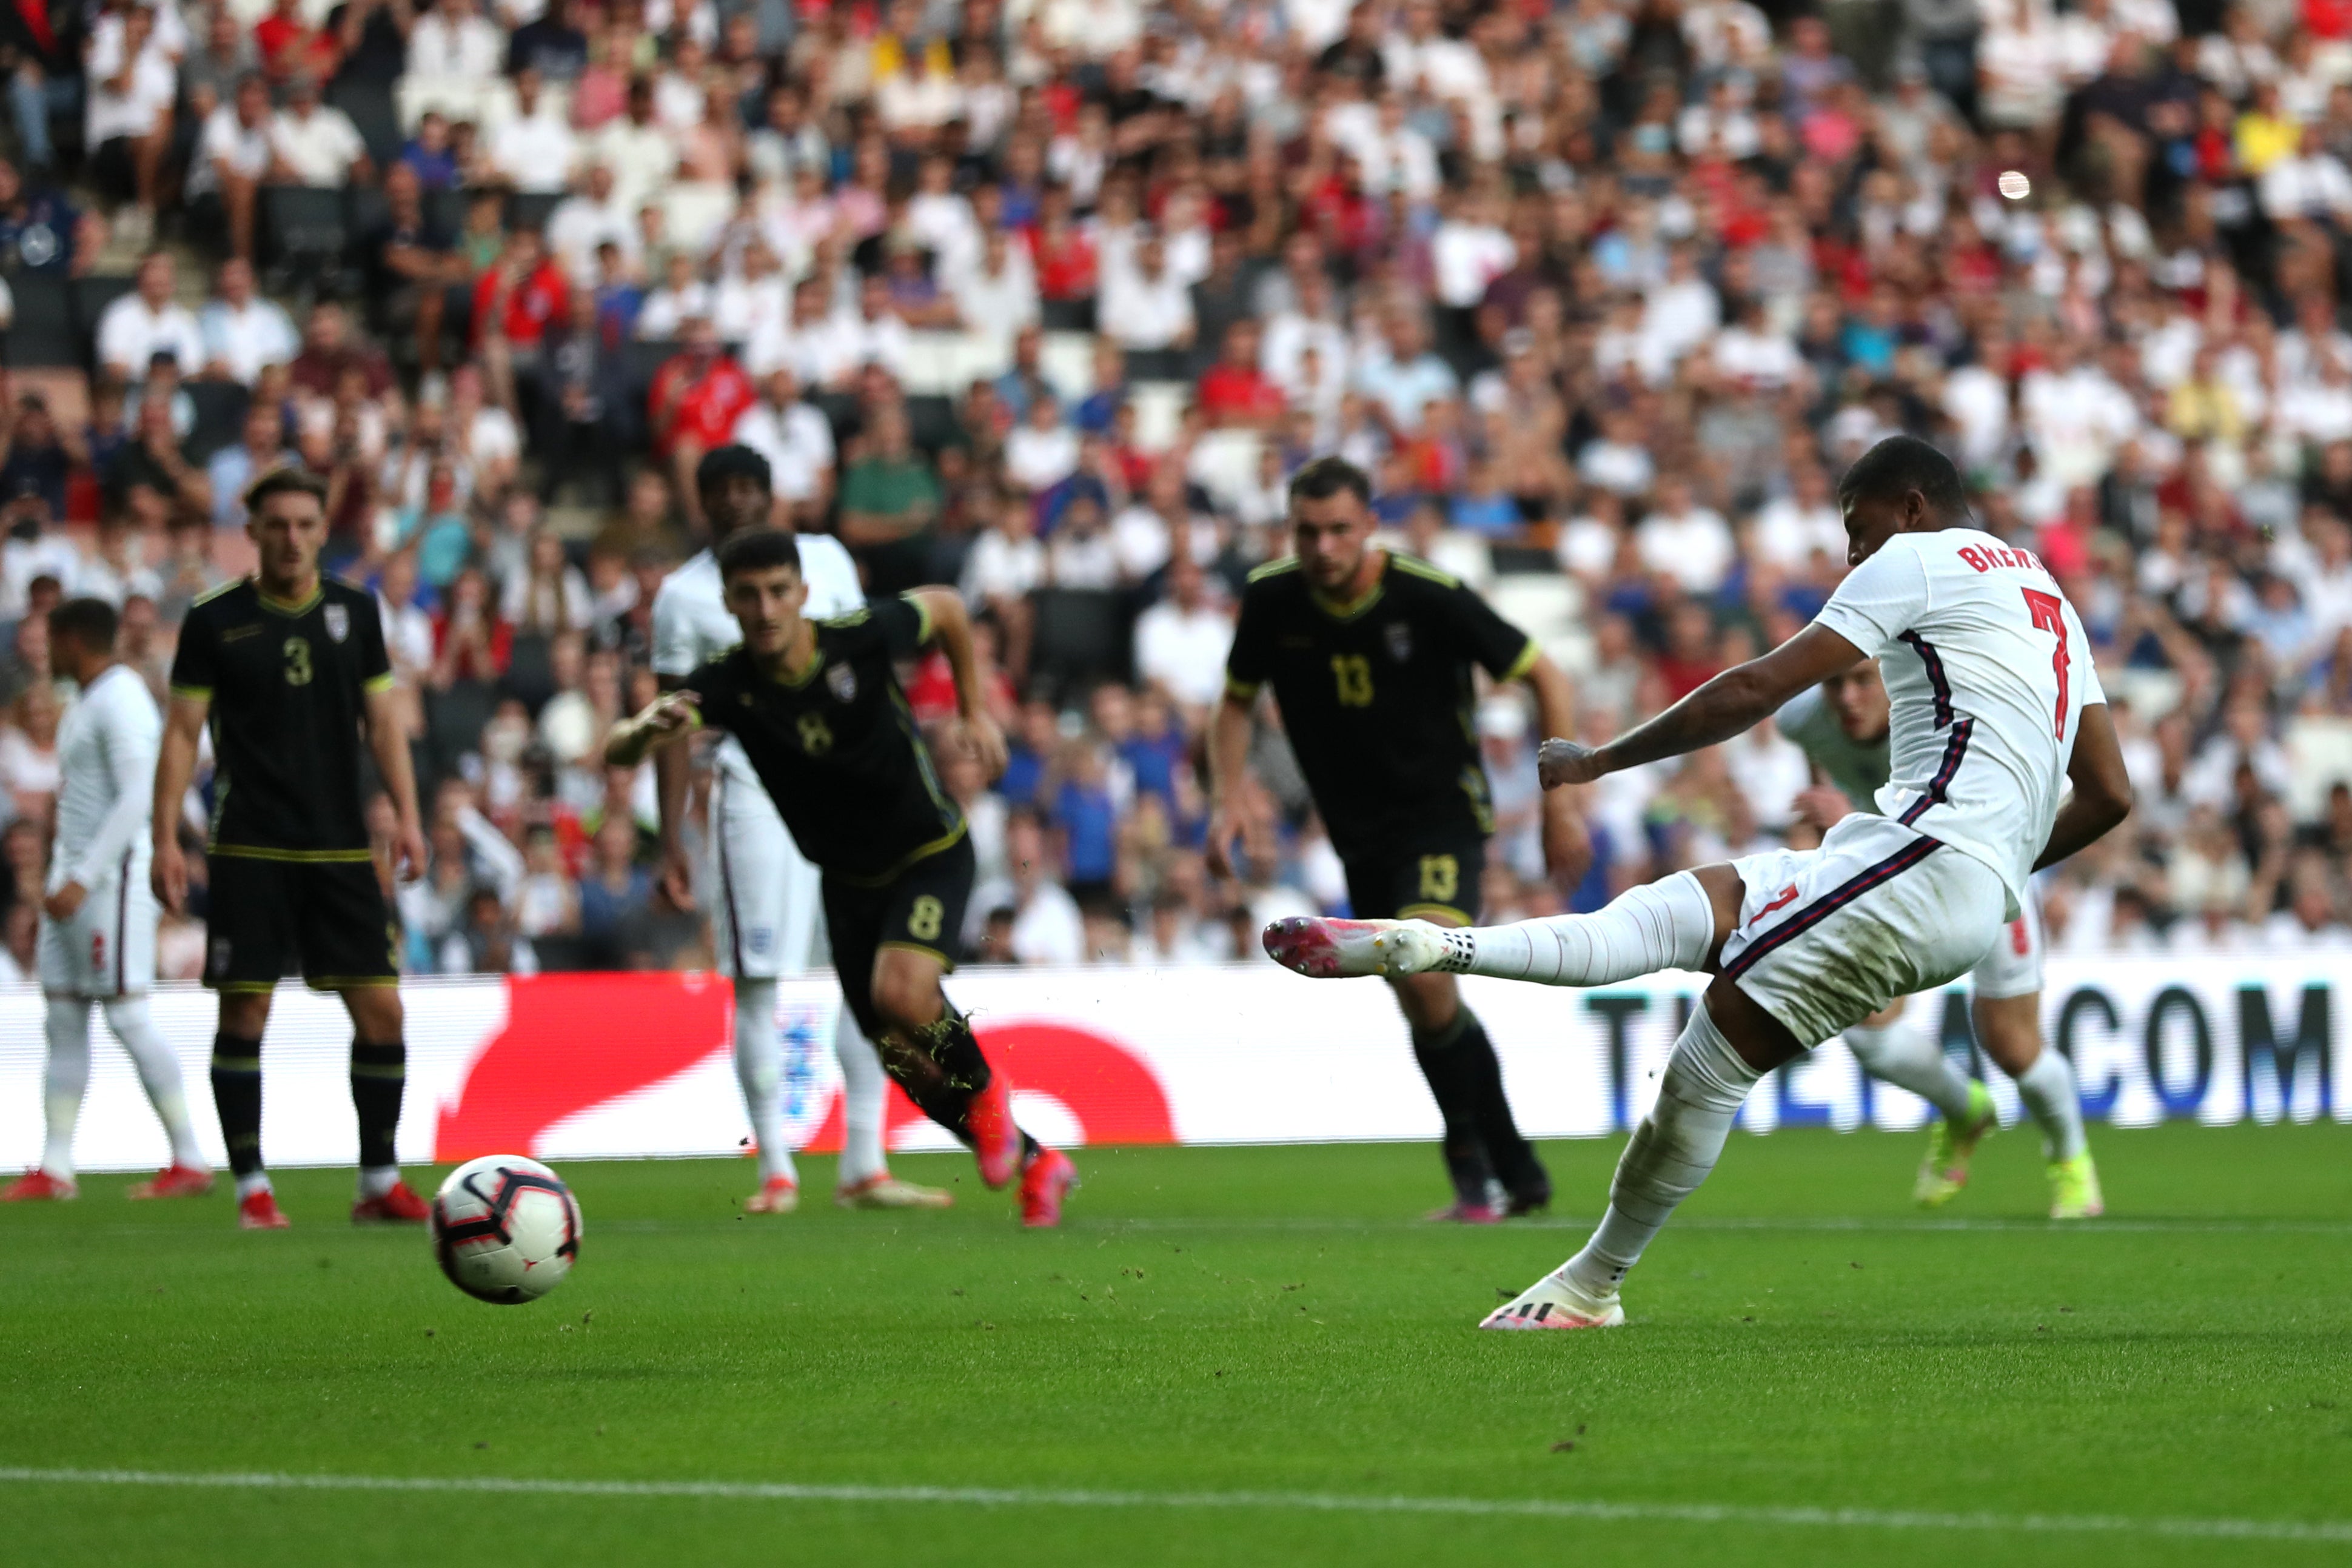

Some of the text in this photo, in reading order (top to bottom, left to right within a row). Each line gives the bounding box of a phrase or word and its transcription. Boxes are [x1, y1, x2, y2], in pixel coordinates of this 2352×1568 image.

[283, 636, 312, 687] 3
[1330, 653, 1375, 708] 13
[2021, 586, 2071, 743] 7
[796, 714, 834, 757] 8
[1418, 854, 1460, 902] 13
[907, 894, 945, 941] 8
